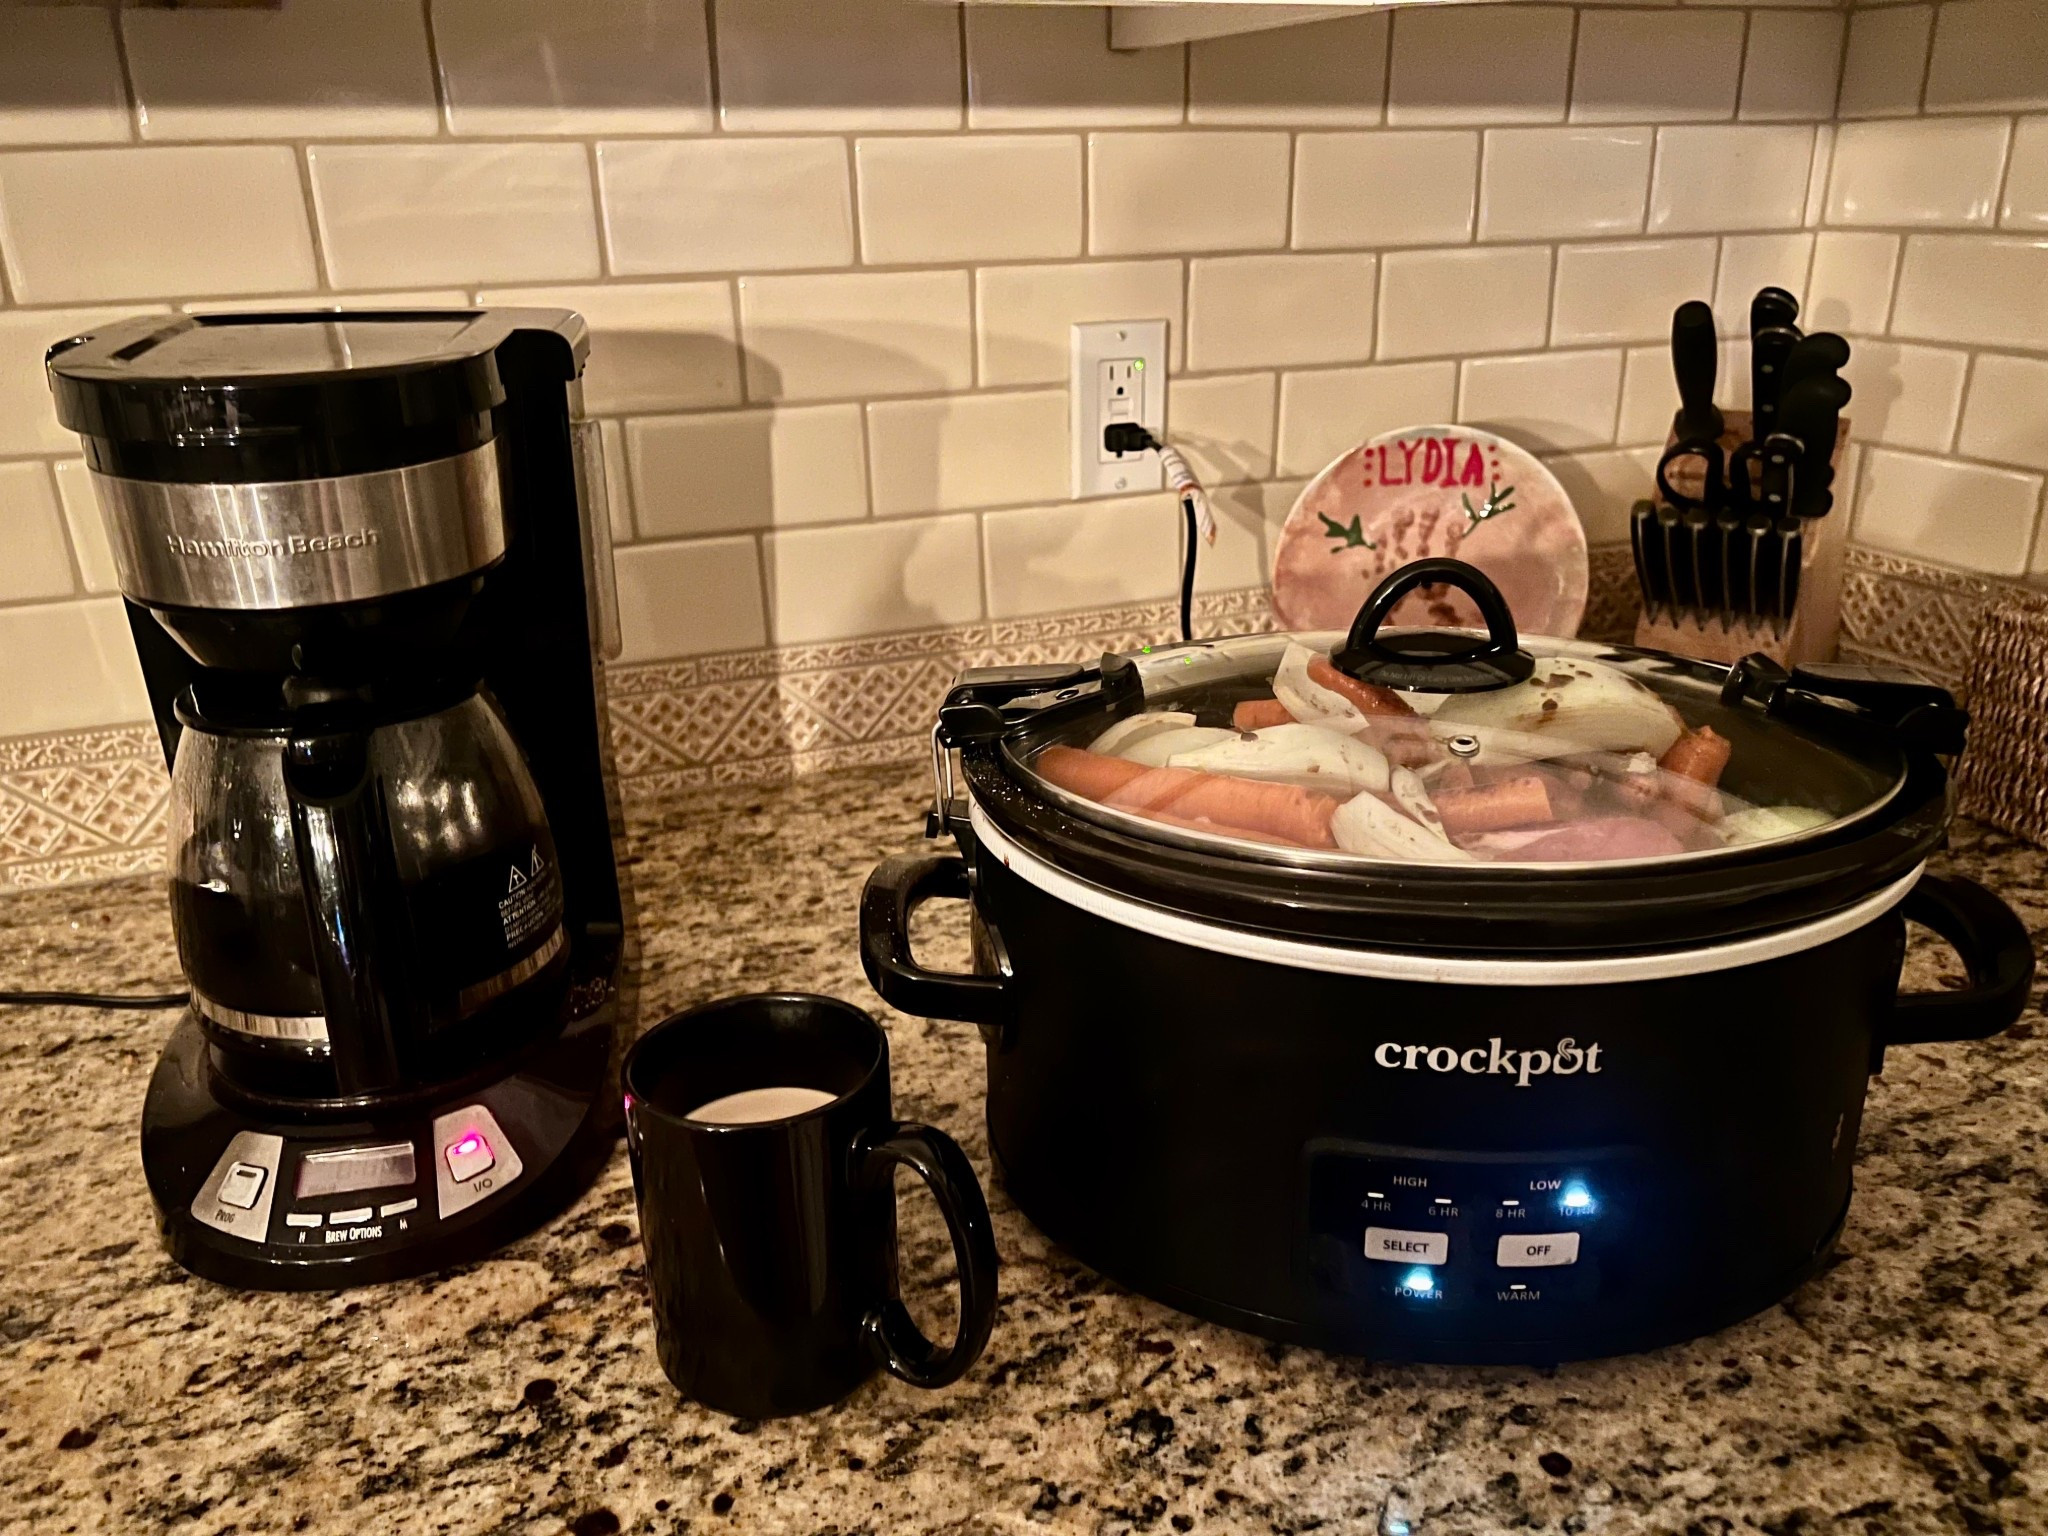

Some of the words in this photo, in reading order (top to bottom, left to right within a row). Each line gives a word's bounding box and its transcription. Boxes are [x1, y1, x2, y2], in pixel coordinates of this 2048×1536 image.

[1378, 437, 1485, 488] LYDIA
[167, 535, 284, 558] Hamilton
[288, 528, 381, 555] Beach
[1374, 1037, 1603, 1087] crockpot
[1393, 1175, 1428, 1188] HIGH
[1529, 1179, 1562, 1191] LOW
[1361, 1199, 1369, 1210] 4
[1371, 1200, 1391, 1212] HR
[1428, 1206, 1436, 1217] 6
[1438, 1207, 1459, 1217] HR
[1495, 1208, 1503, 1218] 8
[1506, 1208, 1526, 1219] HR
[400, 1218, 408, 1230] M
[299, 1231, 306, 1243] H
[1383, 1239, 1430, 1254] SELECT
[1526, 1245, 1552, 1257] OFF
[1394, 1286, 1443, 1300] POWER
[1497, 1290, 1541, 1301] WARM
